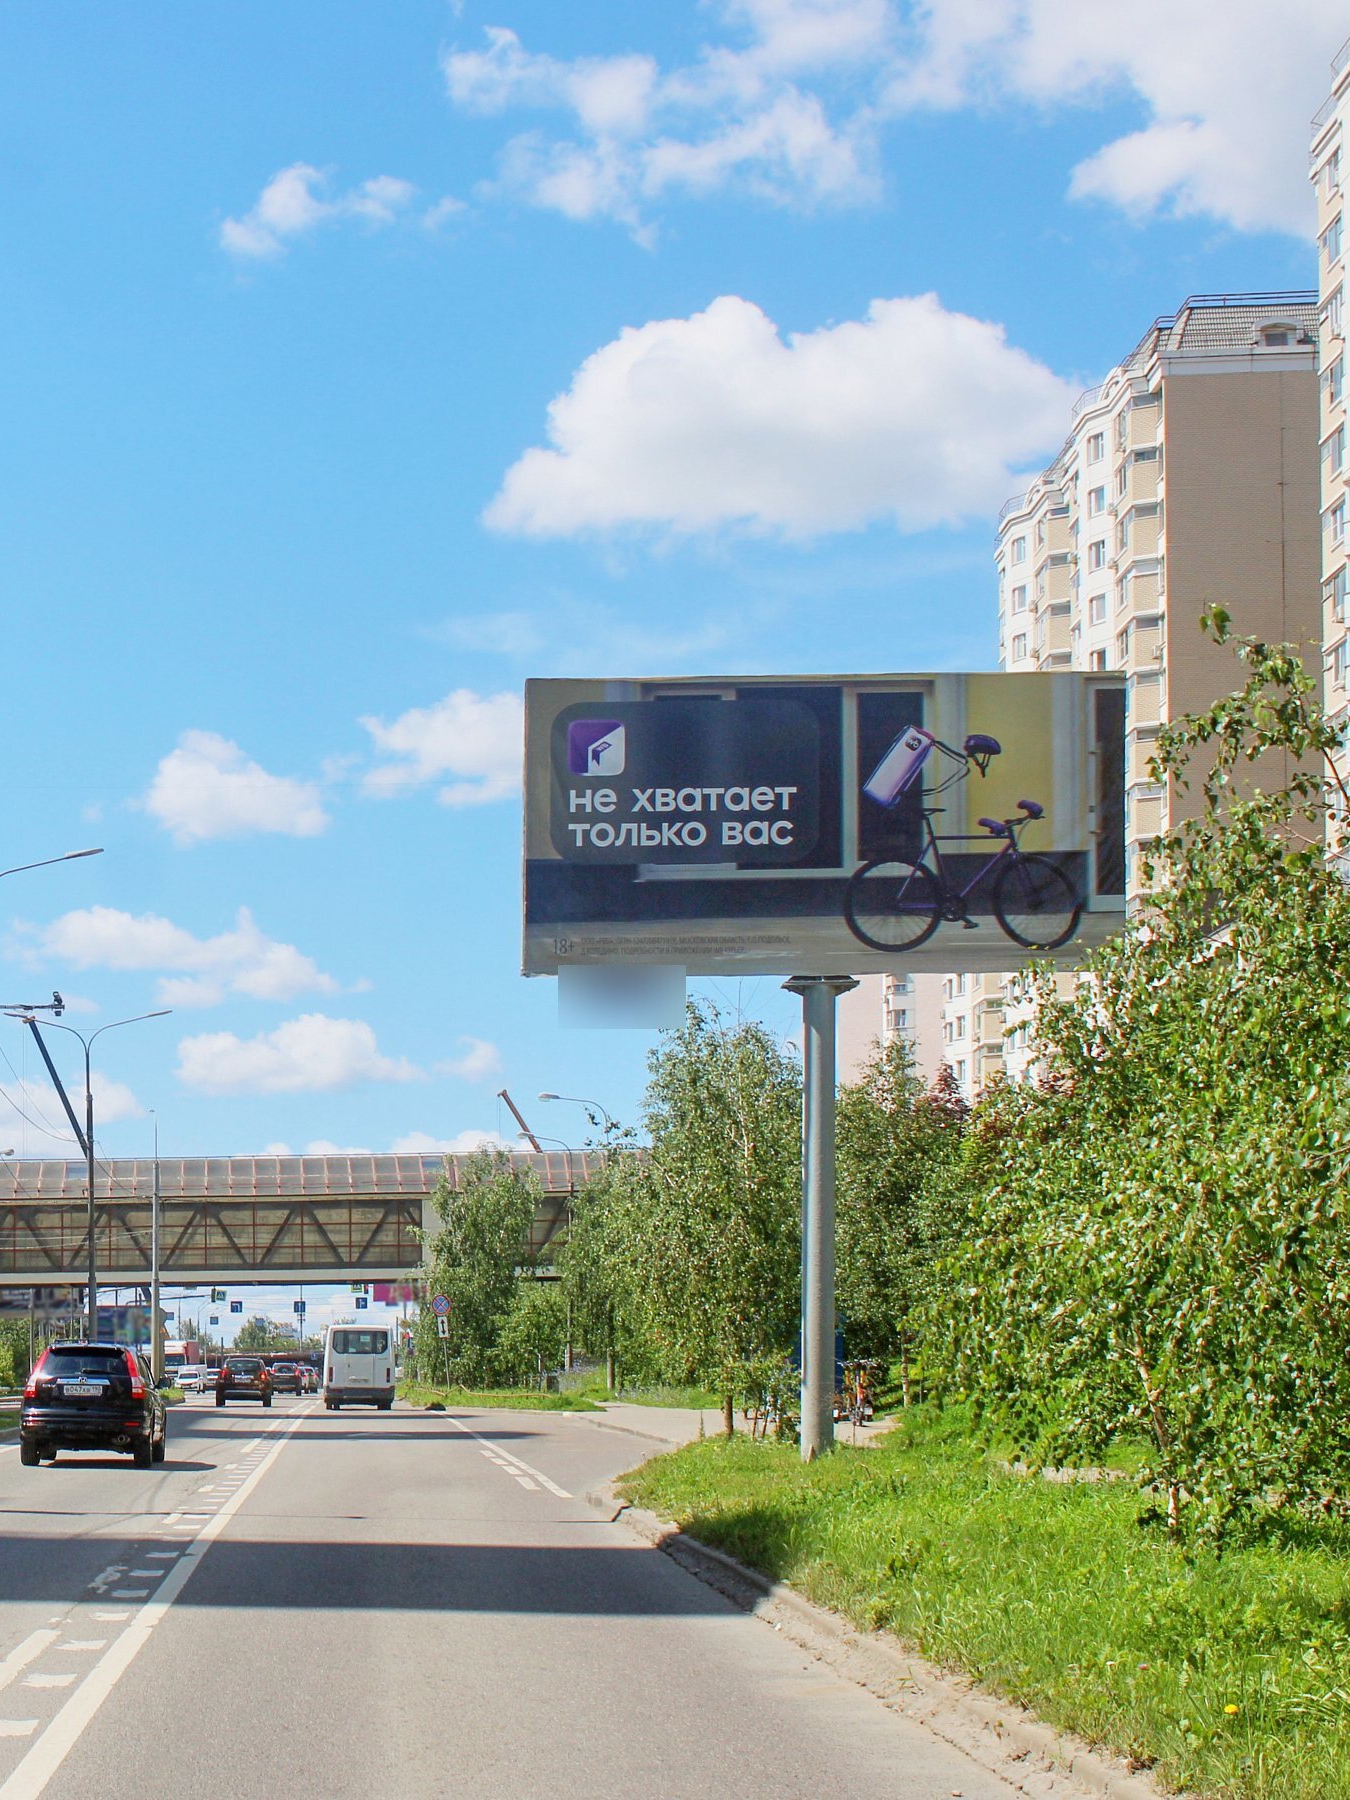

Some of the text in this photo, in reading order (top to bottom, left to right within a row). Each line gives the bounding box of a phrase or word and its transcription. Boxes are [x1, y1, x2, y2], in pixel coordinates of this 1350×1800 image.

[569, 786, 797, 813] не хватает
[568, 820, 794, 847] только вас
[554, 938, 574, 955] 18+
